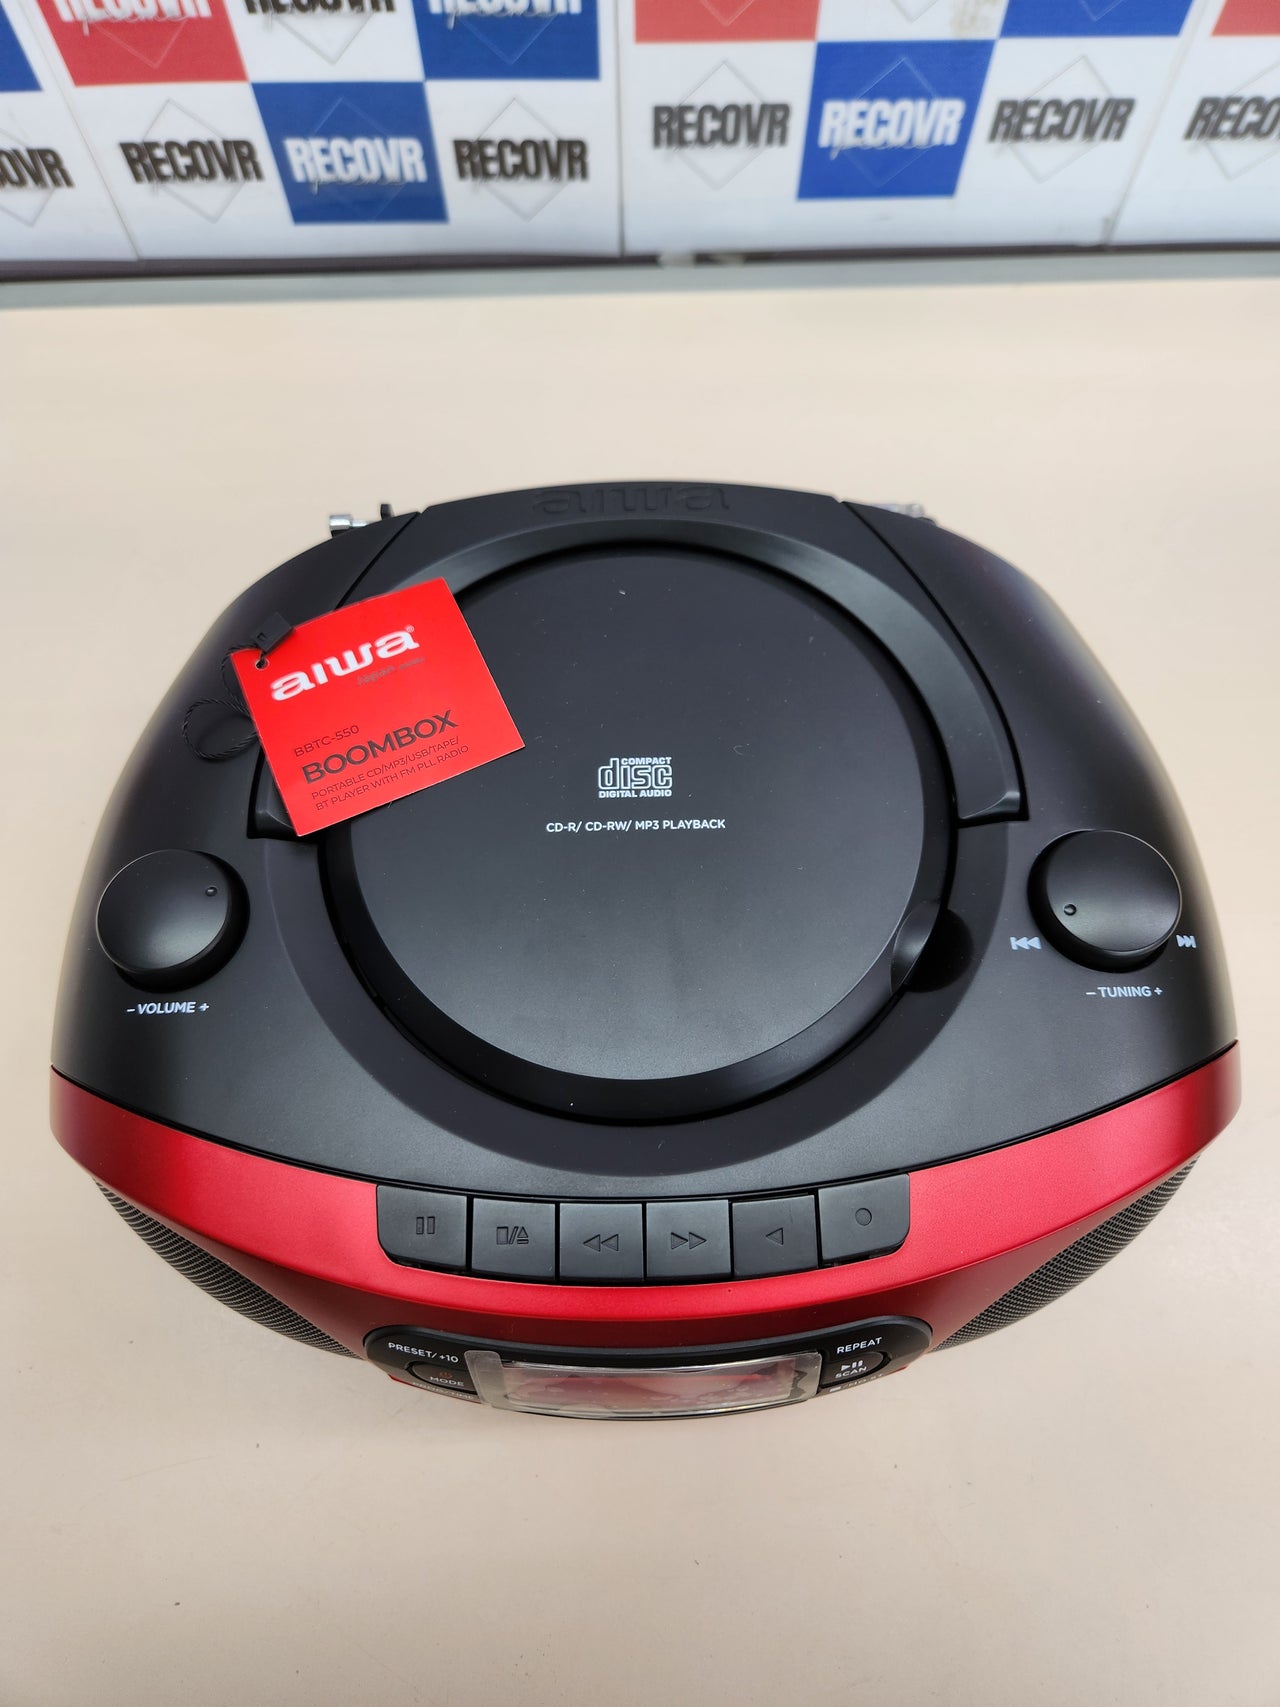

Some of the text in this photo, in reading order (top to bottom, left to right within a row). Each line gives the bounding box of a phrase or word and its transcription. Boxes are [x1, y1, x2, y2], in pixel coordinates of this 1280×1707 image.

[652, 102, 791, 149] RECOVR
[817, 98, 966, 149] RECOVR
[987, 97, 1137, 144] RECOVR
[0, 149, 75, 188] OVR
[119, 139, 265, 183] RECOVR
[284, 137, 428, 183] RECOVR
[453, 138, 589, 181] RECOVR
[270, 629, 420, 701] aiwa
[294, 724, 360, 758] BBTC-550
[301, 709, 459, 785] BOOMBOX
[316, 744, 470, 811] BT PLAYER WITH FM PLL RADIO
[598, 757, 673, 790] disc
[621, 756, 672, 765] COMPACT
[311, 773, 366, 800] PORTABLE
[598, 789, 672, 798] DIGITAL AUDIO
[546, 819, 726, 833] CD-R/ CD-RW/ MP3 PLAYBACK
[388, 1342, 459, 1364] PRESET/ +10
[836, 1337, 882, 1354] REPEAT
[430, 1376, 465, 1387] MODE
[834, 1366, 867, 1379] SCAN
